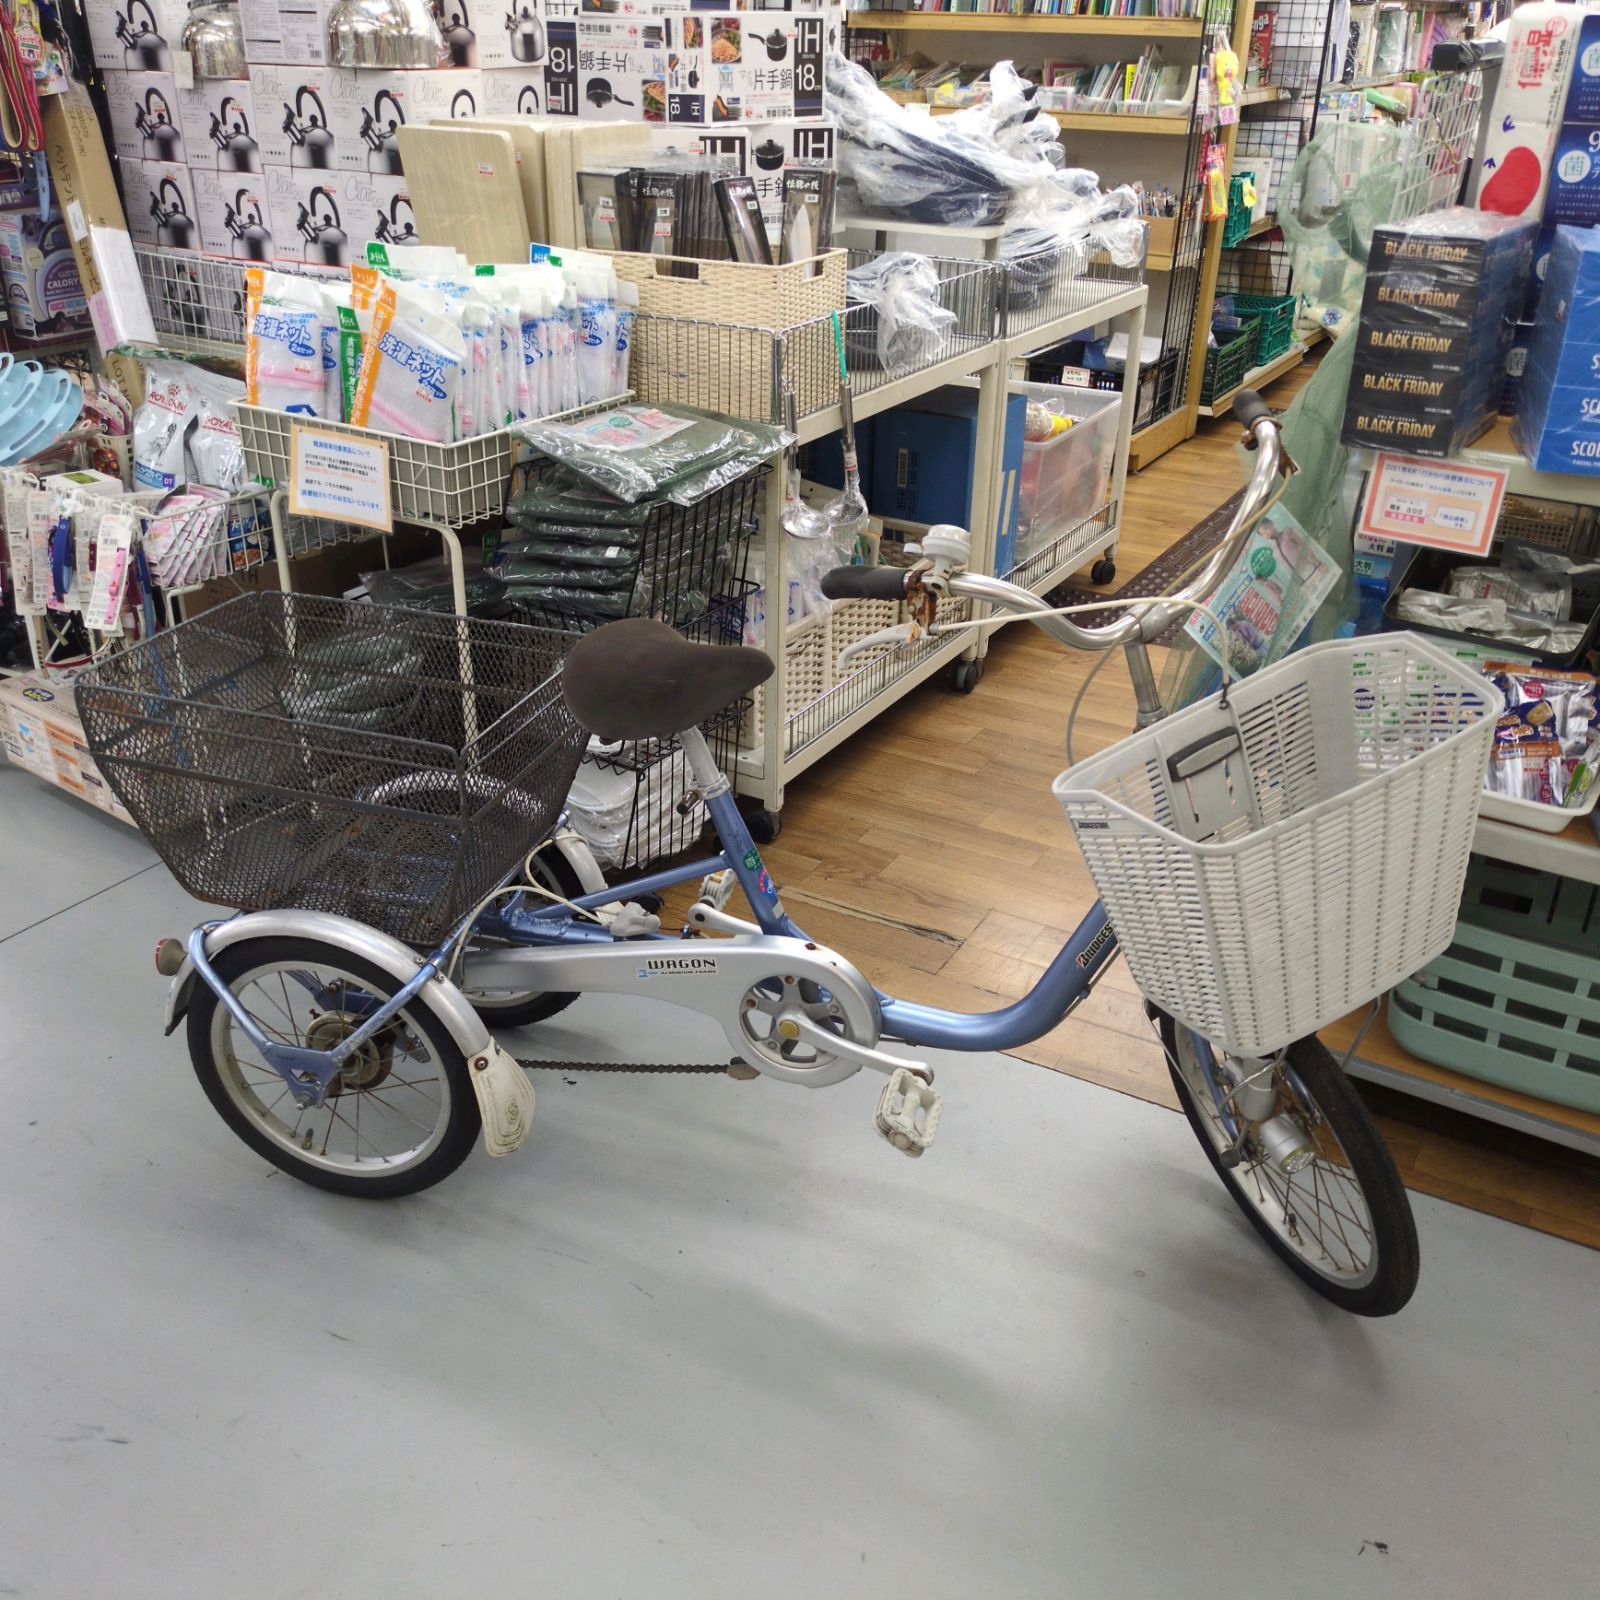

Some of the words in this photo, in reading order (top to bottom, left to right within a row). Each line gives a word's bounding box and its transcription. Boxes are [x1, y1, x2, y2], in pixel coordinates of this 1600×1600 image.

[798, 21, 820, 53] IH
[550, 46, 575, 73] 18
[580, 50, 628, 73] 片手鍋
[753, 68, 793, 91] 片手鍋
[796, 63, 815, 91] 18
[547, 82, 573, 113] IH
[670, 96, 680, 115] 18
[691, 101, 700, 116] IH
[799, 131, 829, 160] IH
[1384, 241, 1424, 258] BLACK
[1426, 244, 1468, 262] FRIDAY
[1377, 287, 1416, 304] BLACK
[1418, 290, 1460, 307] FRIDAY
[253, 314, 311, 342] 洗濯ネット
[1370, 331, 1409, 348] BLACK
[1411, 335, 1452, 353] FRIDAY
[378, 332, 446, 385] 洗濯ネット
[1363, 374, 1402, 391] BLACK
[1403, 378, 1443, 396] FRIDAY
[1356, 416, 1395, 434] BLACK
[1396, 421, 1436, 438] FRIDAY
[164, 477, 173, 485] DT
[1406, 506, 1423, 515] 300
[1076, 921, 1114, 969] BRIDGES
[647, 959, 716, 970] WAGON
